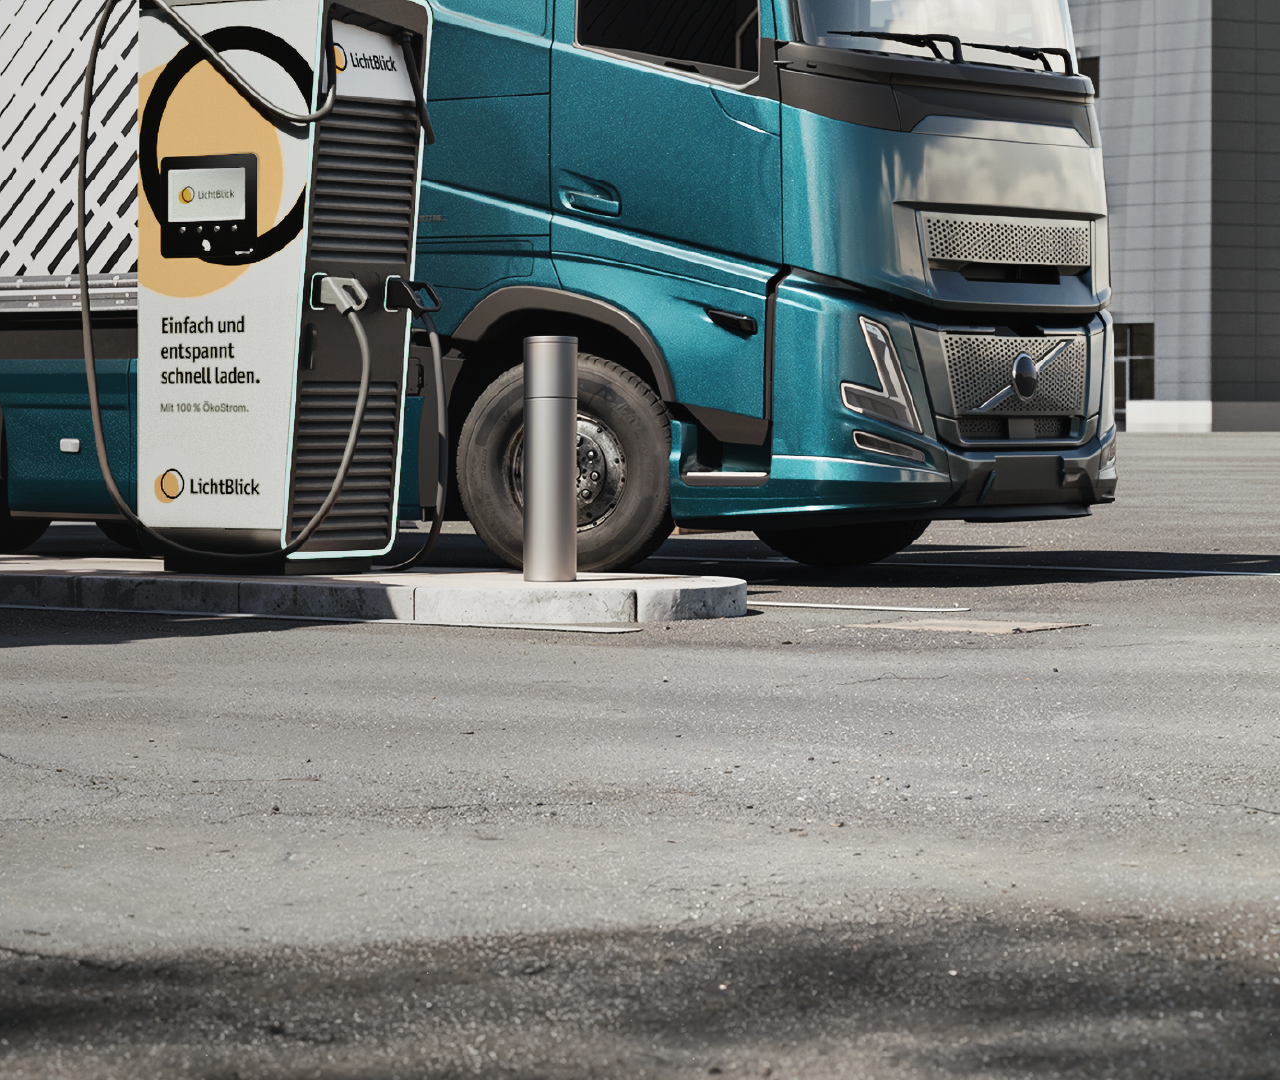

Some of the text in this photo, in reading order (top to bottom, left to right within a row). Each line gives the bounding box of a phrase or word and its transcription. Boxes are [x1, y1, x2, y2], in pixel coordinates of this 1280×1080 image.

[349, 52, 397, 72] LichtBlick
[197, 189, 235, 200] LichtBlick
[161, 315, 245, 334] Einfach und
[160, 343, 235, 362] entspannt
[160, 367, 260, 384] schnell laden.
[160, 403, 174, 413] Mit
[177, 403, 191, 413] 100
[190, 478, 260, 496] LichtBlick
